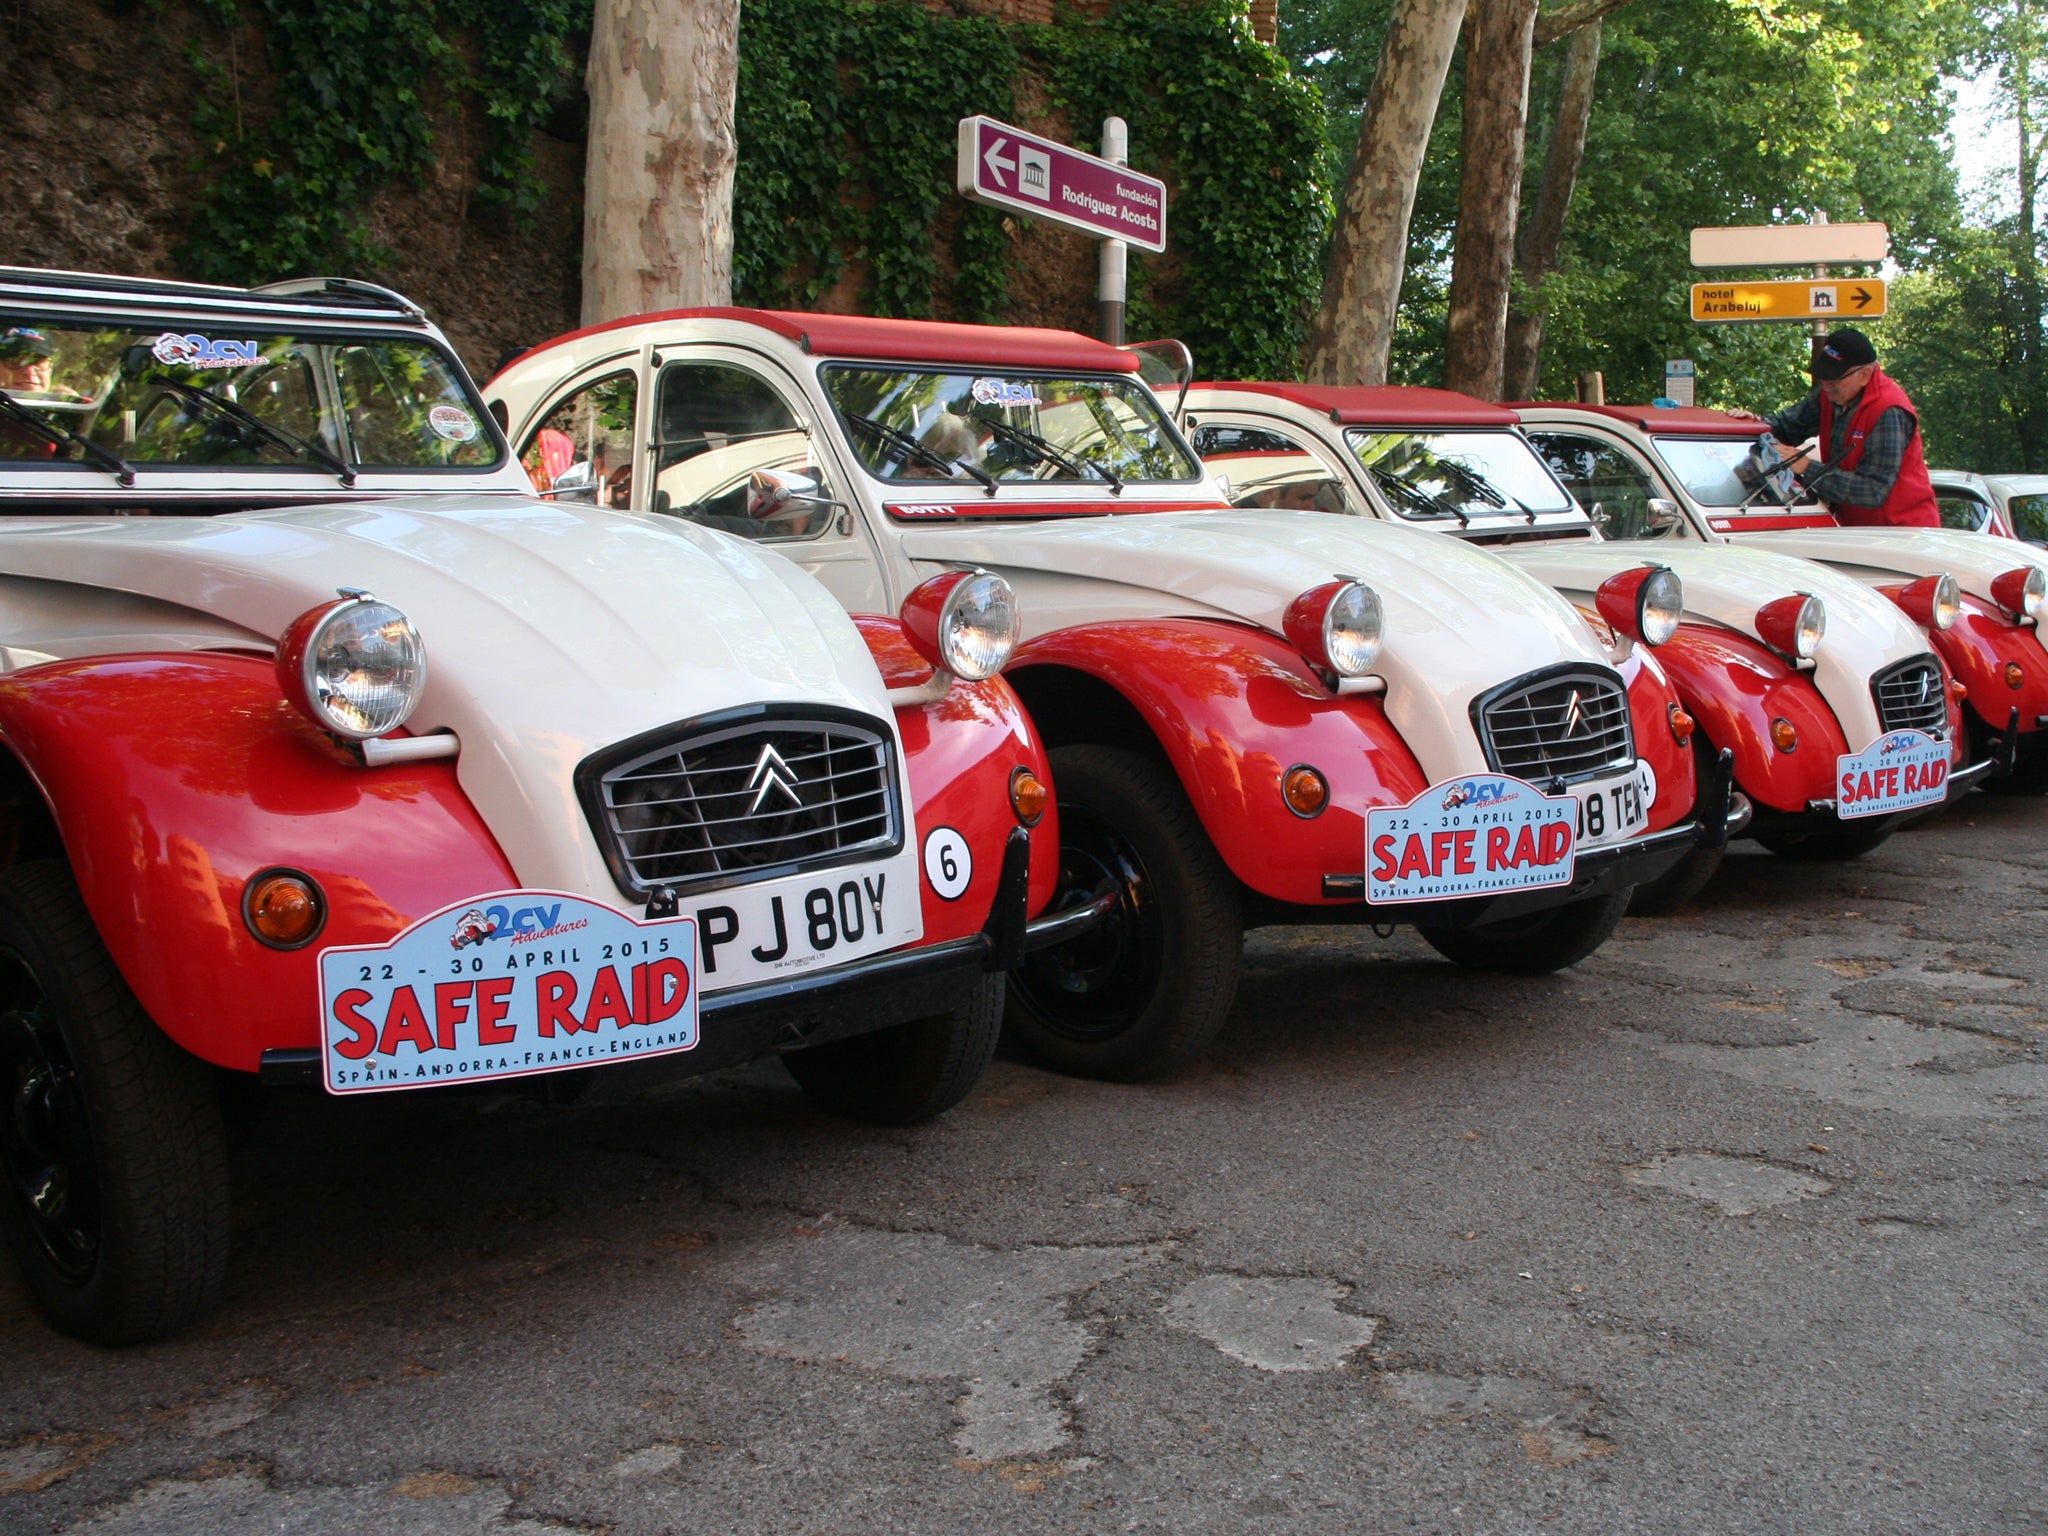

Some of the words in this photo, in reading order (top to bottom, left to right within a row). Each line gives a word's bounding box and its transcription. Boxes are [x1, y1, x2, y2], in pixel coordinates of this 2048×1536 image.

[1121, 206, 1158, 230] Acosta
[1702, 289, 1734, 299] hotel
[1703, 301, 1761, 314] Arabeluj
[197, 357, 269, 369] Adventures
[1851, 762, 1862, 770] 22
[1897, 755, 1919, 764] APRIL
[1925, 750, 1944, 759] 2015
[1841, 767, 1899, 804] SAFE
[1904, 758, 1947, 794] RAID
[1389, 819, 1409, 830] 22
[1441, 815, 1460, 827] 30
[1472, 811, 1513, 824] APRIL
[1525, 808, 1563, 820] 2015
[940, 844, 958, 882] 6
[1372, 830, 1476, 882] SAFE
[1486, 821, 1571, 872] RAID
[510, 918, 589, 947] Adventures
[360, 965, 394, 981] 22
[451, 957, 484, 974] 30
[507, 949, 581, 969] APRIL
[602, 938, 670, 960] 2015
[784, 955, 815, 967] AUTOMOTIVE
[333, 977, 518, 1060] SAFE
[535, 956, 690, 1038] RAID
